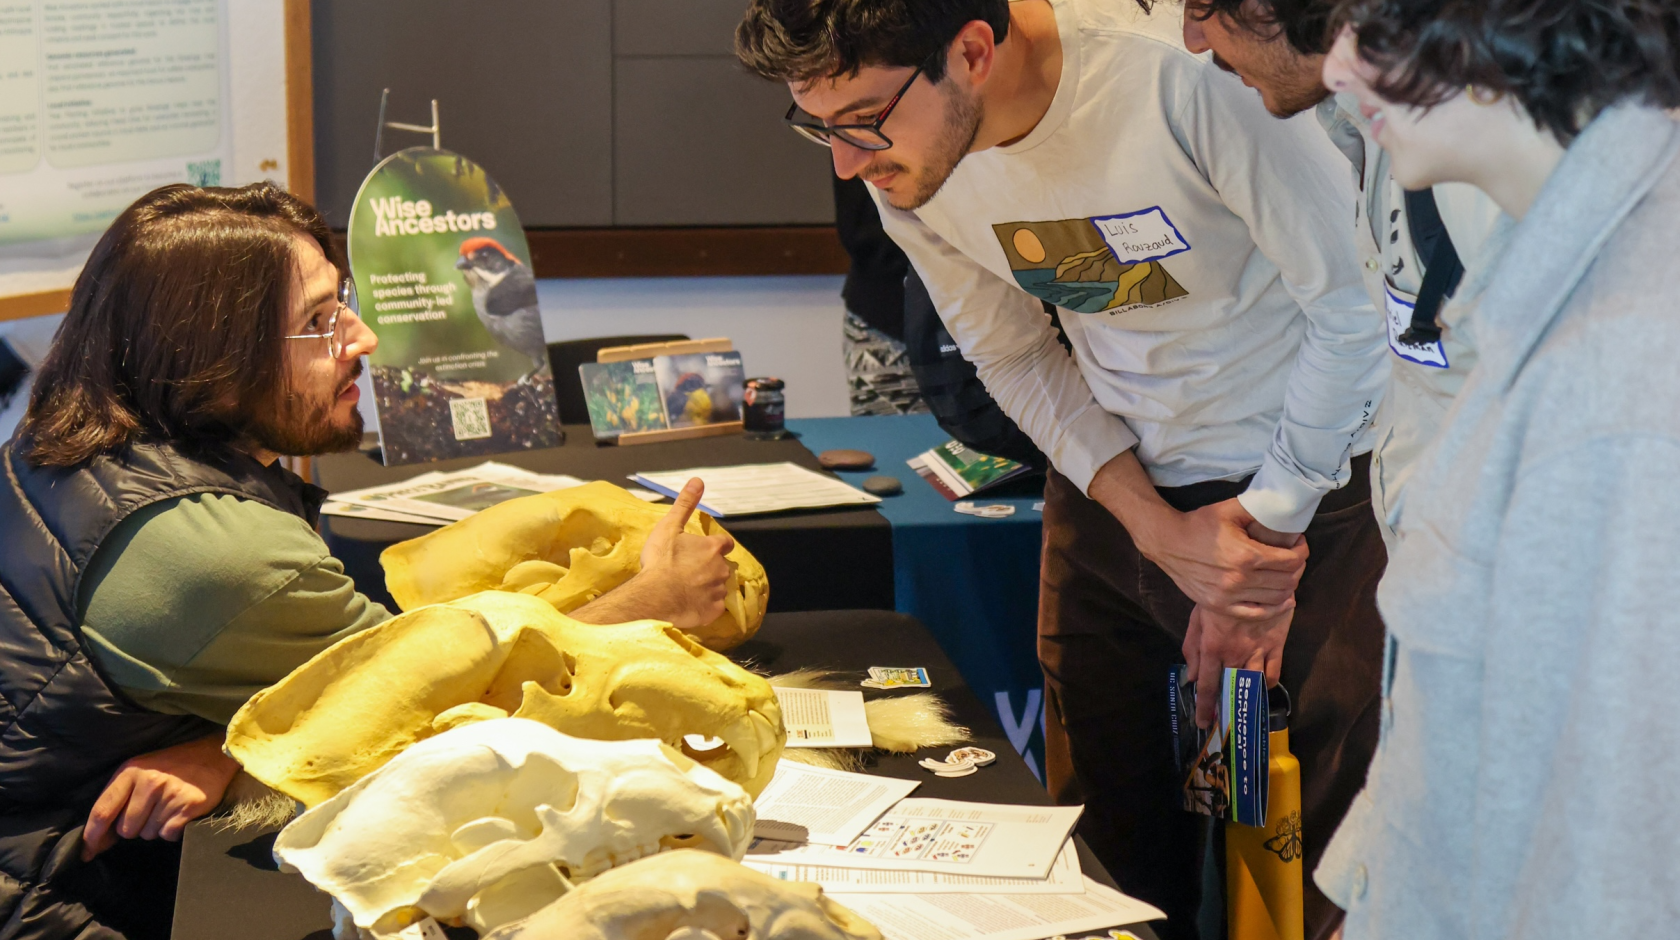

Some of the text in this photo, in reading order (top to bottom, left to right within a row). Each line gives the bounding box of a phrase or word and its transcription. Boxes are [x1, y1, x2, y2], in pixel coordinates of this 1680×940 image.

[369, 196, 432, 219] Wise
[375, 210, 497, 237] Ancestors
[369, 272, 426, 285] Protecting
[373, 282, 456, 299] species through
[375, 295, 453, 311] community-led
[377, 310, 446, 324] conservation
[1237, 676, 1245, 750] Survival
[1242, 677, 1252, 796] Sequence to
